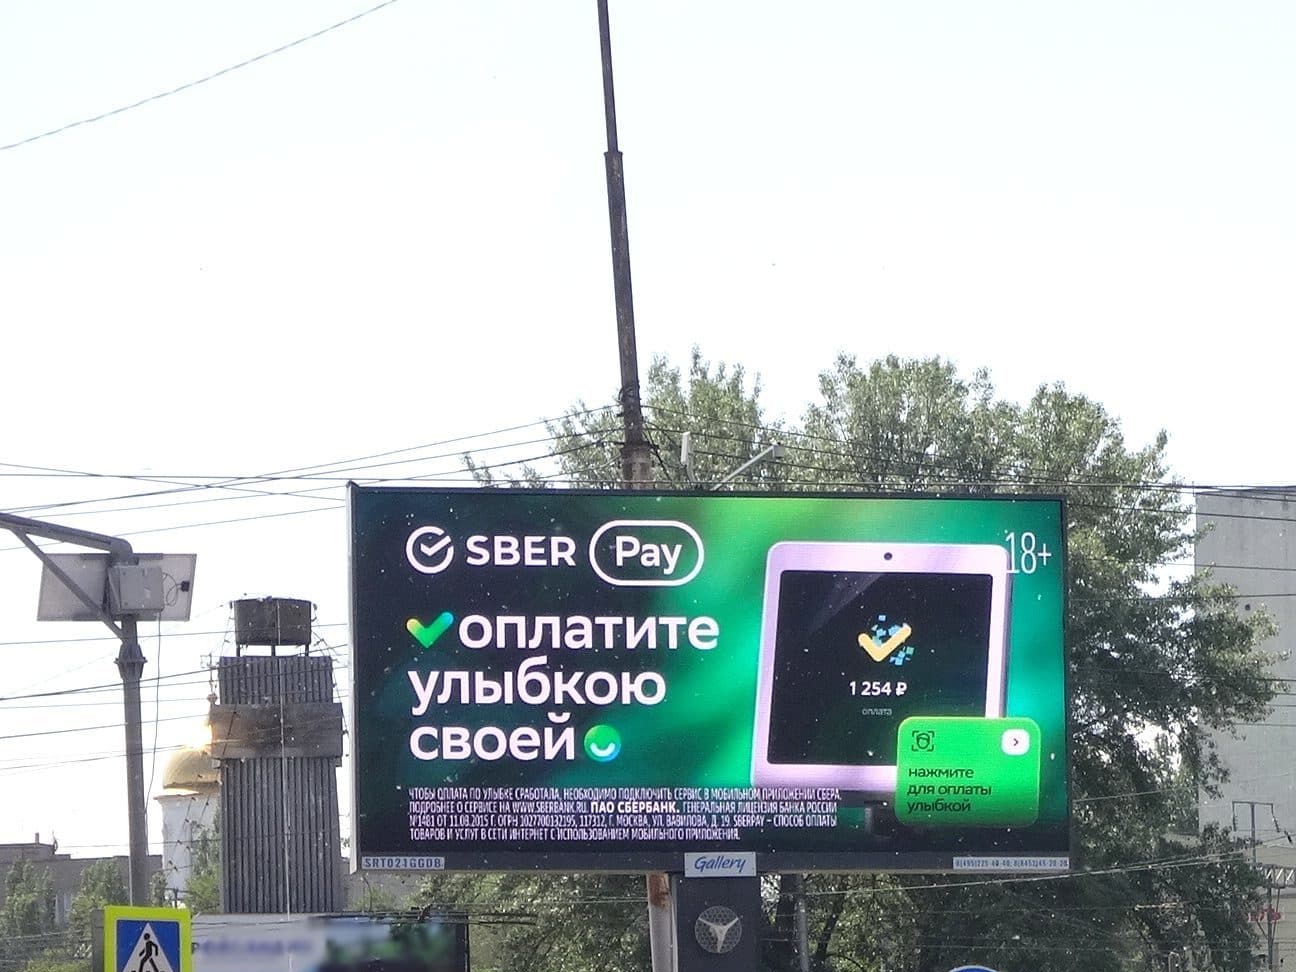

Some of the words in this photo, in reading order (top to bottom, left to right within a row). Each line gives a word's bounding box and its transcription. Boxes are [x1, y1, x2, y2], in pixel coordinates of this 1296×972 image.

[465, 535, 577, 567] SBER
[615, 535, 683, 575] Pay
[1005, 531, 1052, 574] 18+
[458, 614, 720, 650] оплатите
[407, 655, 667, 716] улыбкою
[861, 681, 892, 696] 254
[409, 712, 576, 761] своей
[908, 767, 975, 779] нажмите
[408, 787, 436, 800] ЧТОБЫ
[437, 787, 469, 800] ОПЛАТА
[470, 787, 481, 800] ПО
[483, 787, 513, 800] УЛЫБКЕ
[563, 787, 617, 800] НЕОБХОДИМО
[619, 787, 673, 800] ПОДКЛЮЧИТЬ
[674, 787, 703, 800] СЕРВИС
[711, 787, 761, 800] МОБИЛЬНОМ
[762, 787, 816, 800] ПРИЛОЖЕНИИ
[907, 784, 936, 797] для
[938, 784, 992, 796] оплаты
[409, 801, 455, 813] ПОДРОБНЕЕ
[456, 801, 463, 813] О
[464, 801, 497, 813] СЕРВИСЕ
[499, 801, 511, 813] НА
[590, 801, 616, 813] ПАО
[617, 801, 680, 813] СБЕРБАНК.
[682, 801, 736, 813] ГЕНЕРАЛЬНАЯ
[737, 801, 778, 813] ЛИЦЕНЗИЯ
[779, 801, 805, 813] БАНКА
[806, 801, 837, 813] РОССИИ
[907, 798, 972, 814] улыбкой
[436, 814, 447, 827] ОТ
[497, 814, 519, 827] ОГРН
[773, 814, 804, 827] СПОСОБ
[805, 814, 837, 827] ОПЛАТЫ
[410, 827, 446, 840] ТОВАРОВ
[454, 827, 479, 840] УСЛУГ
[487, 827, 508, 840] СЕТИ
[509, 827, 549, 840] ИНТЕРНЕТ
[557, 827, 630, 840] ИСПОЛЬЗОВАНИЕМ
[631, 827, 684, 840] МОБИЛЬНОГО
[694, 855, 747, 873] Gallery
